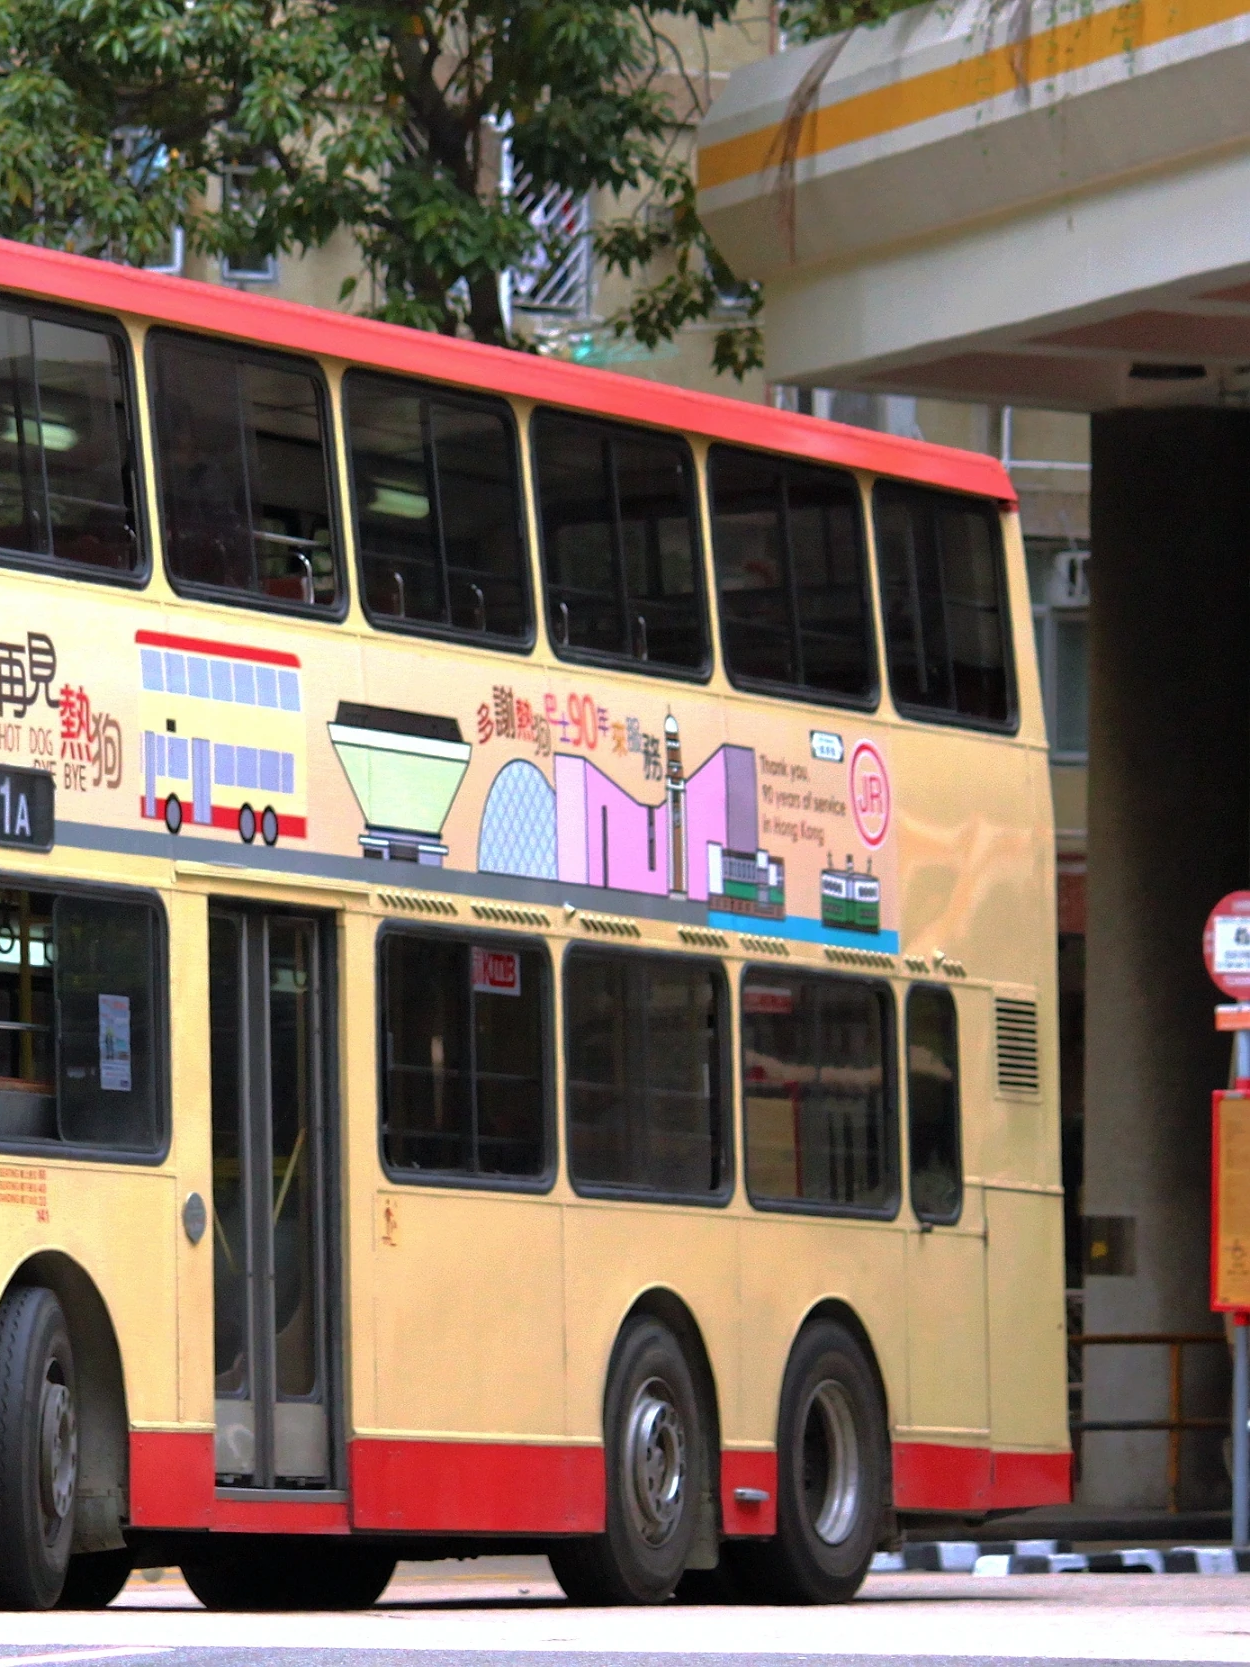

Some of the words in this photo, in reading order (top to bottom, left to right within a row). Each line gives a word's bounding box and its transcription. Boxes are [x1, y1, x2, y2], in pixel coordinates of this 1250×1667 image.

[0, 722, 22, 752] HOT
[29, 728, 54, 756] DOG
[64, 763, 87, 792] BYE
[857, 774, 883, 813] JR
[773, 815, 799, 843] Hong
[800, 820, 824, 847] Kong
